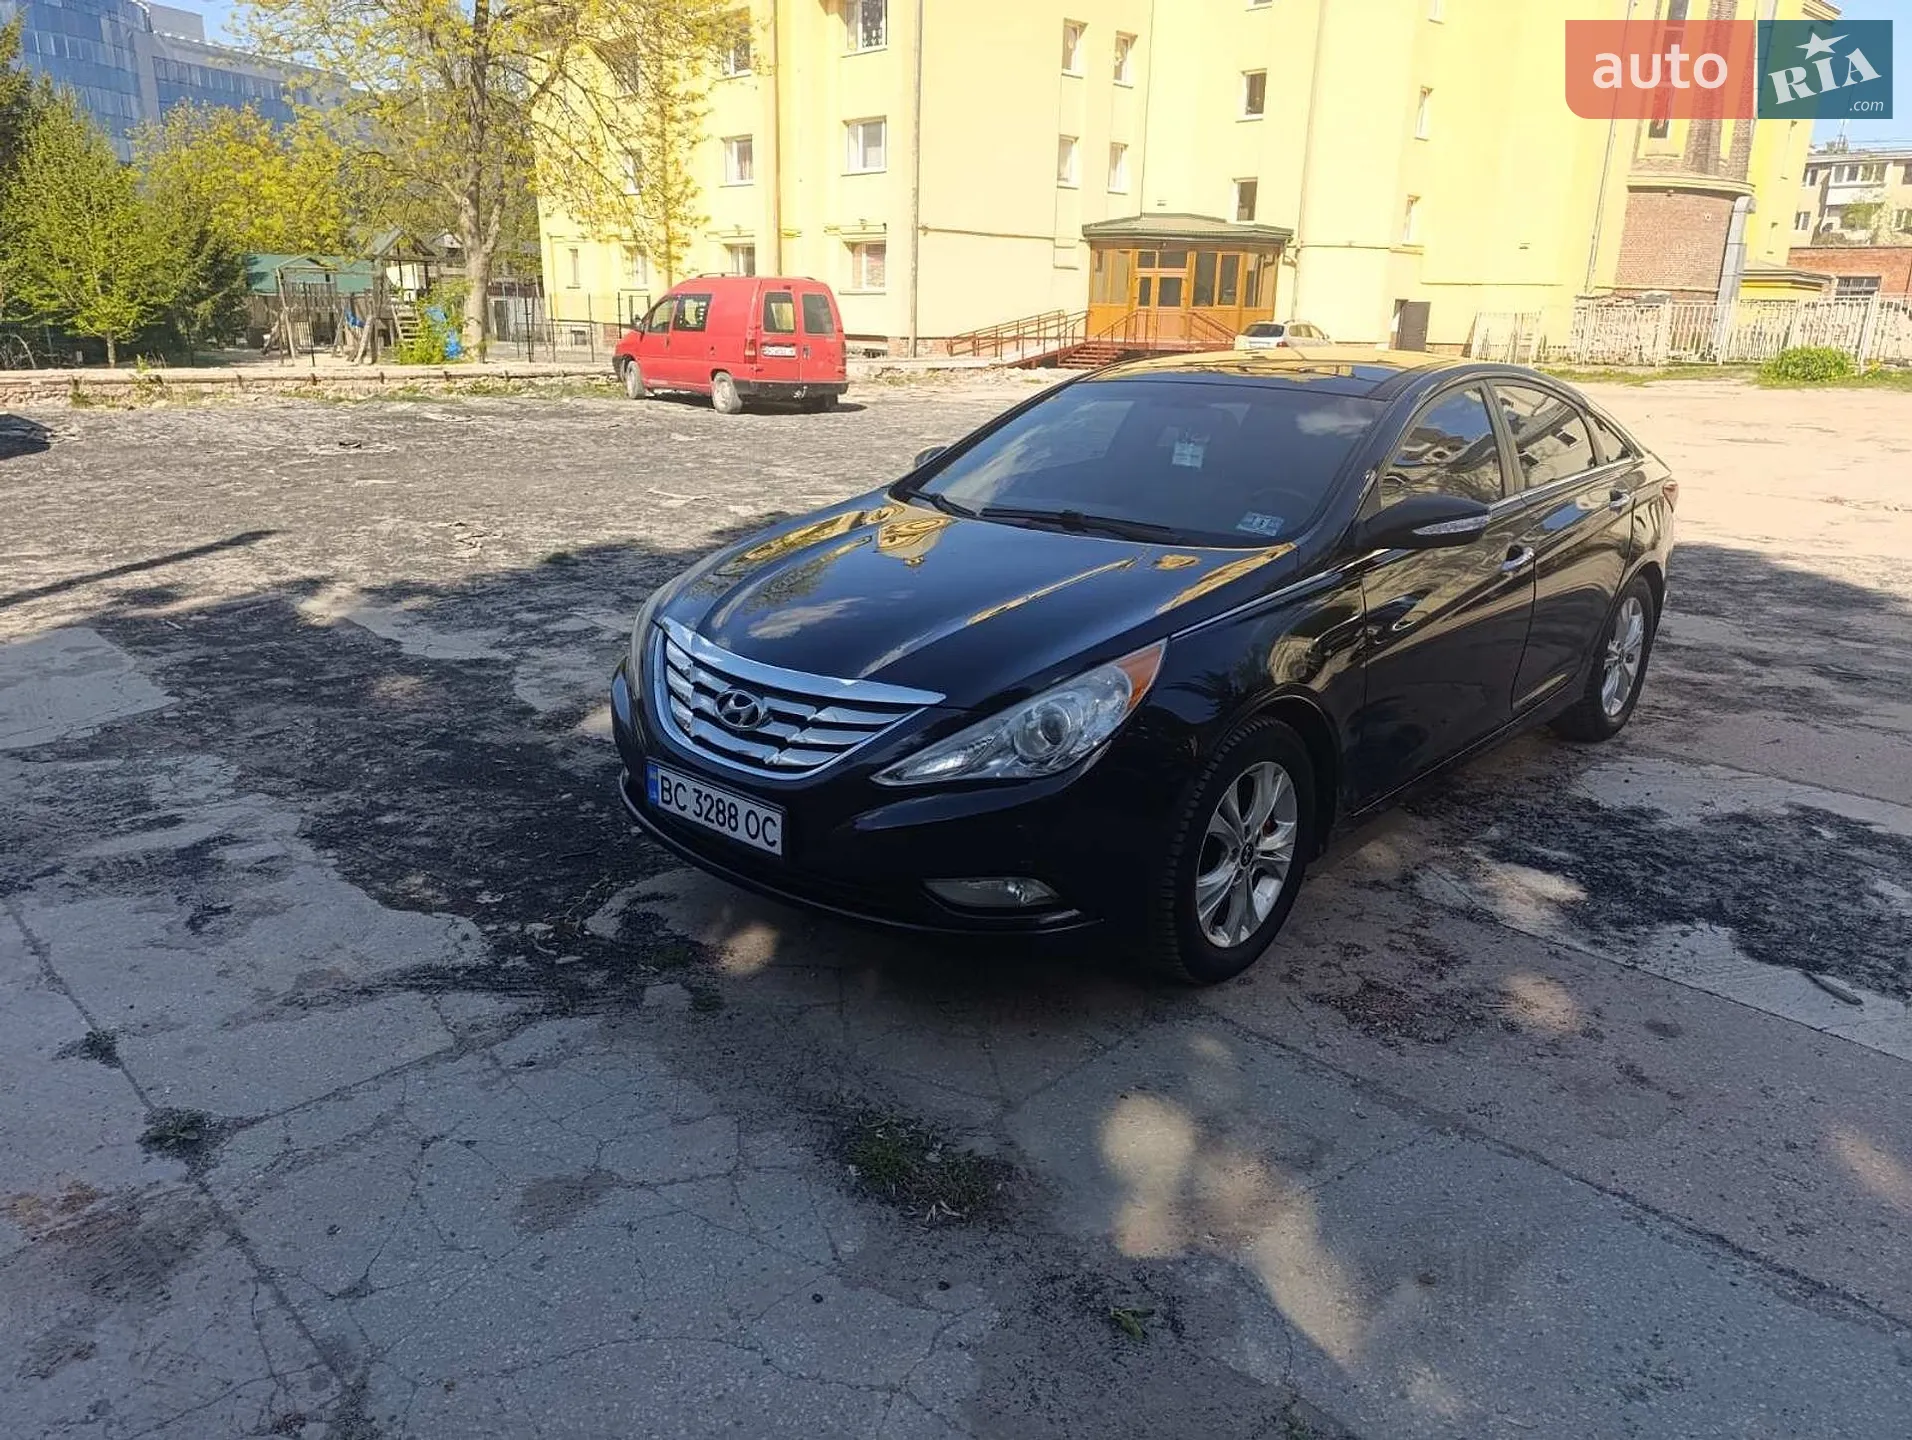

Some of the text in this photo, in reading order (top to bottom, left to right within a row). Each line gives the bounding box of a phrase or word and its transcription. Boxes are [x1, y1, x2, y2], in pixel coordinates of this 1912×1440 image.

[660, 775, 777, 847] BC 3288 OC
